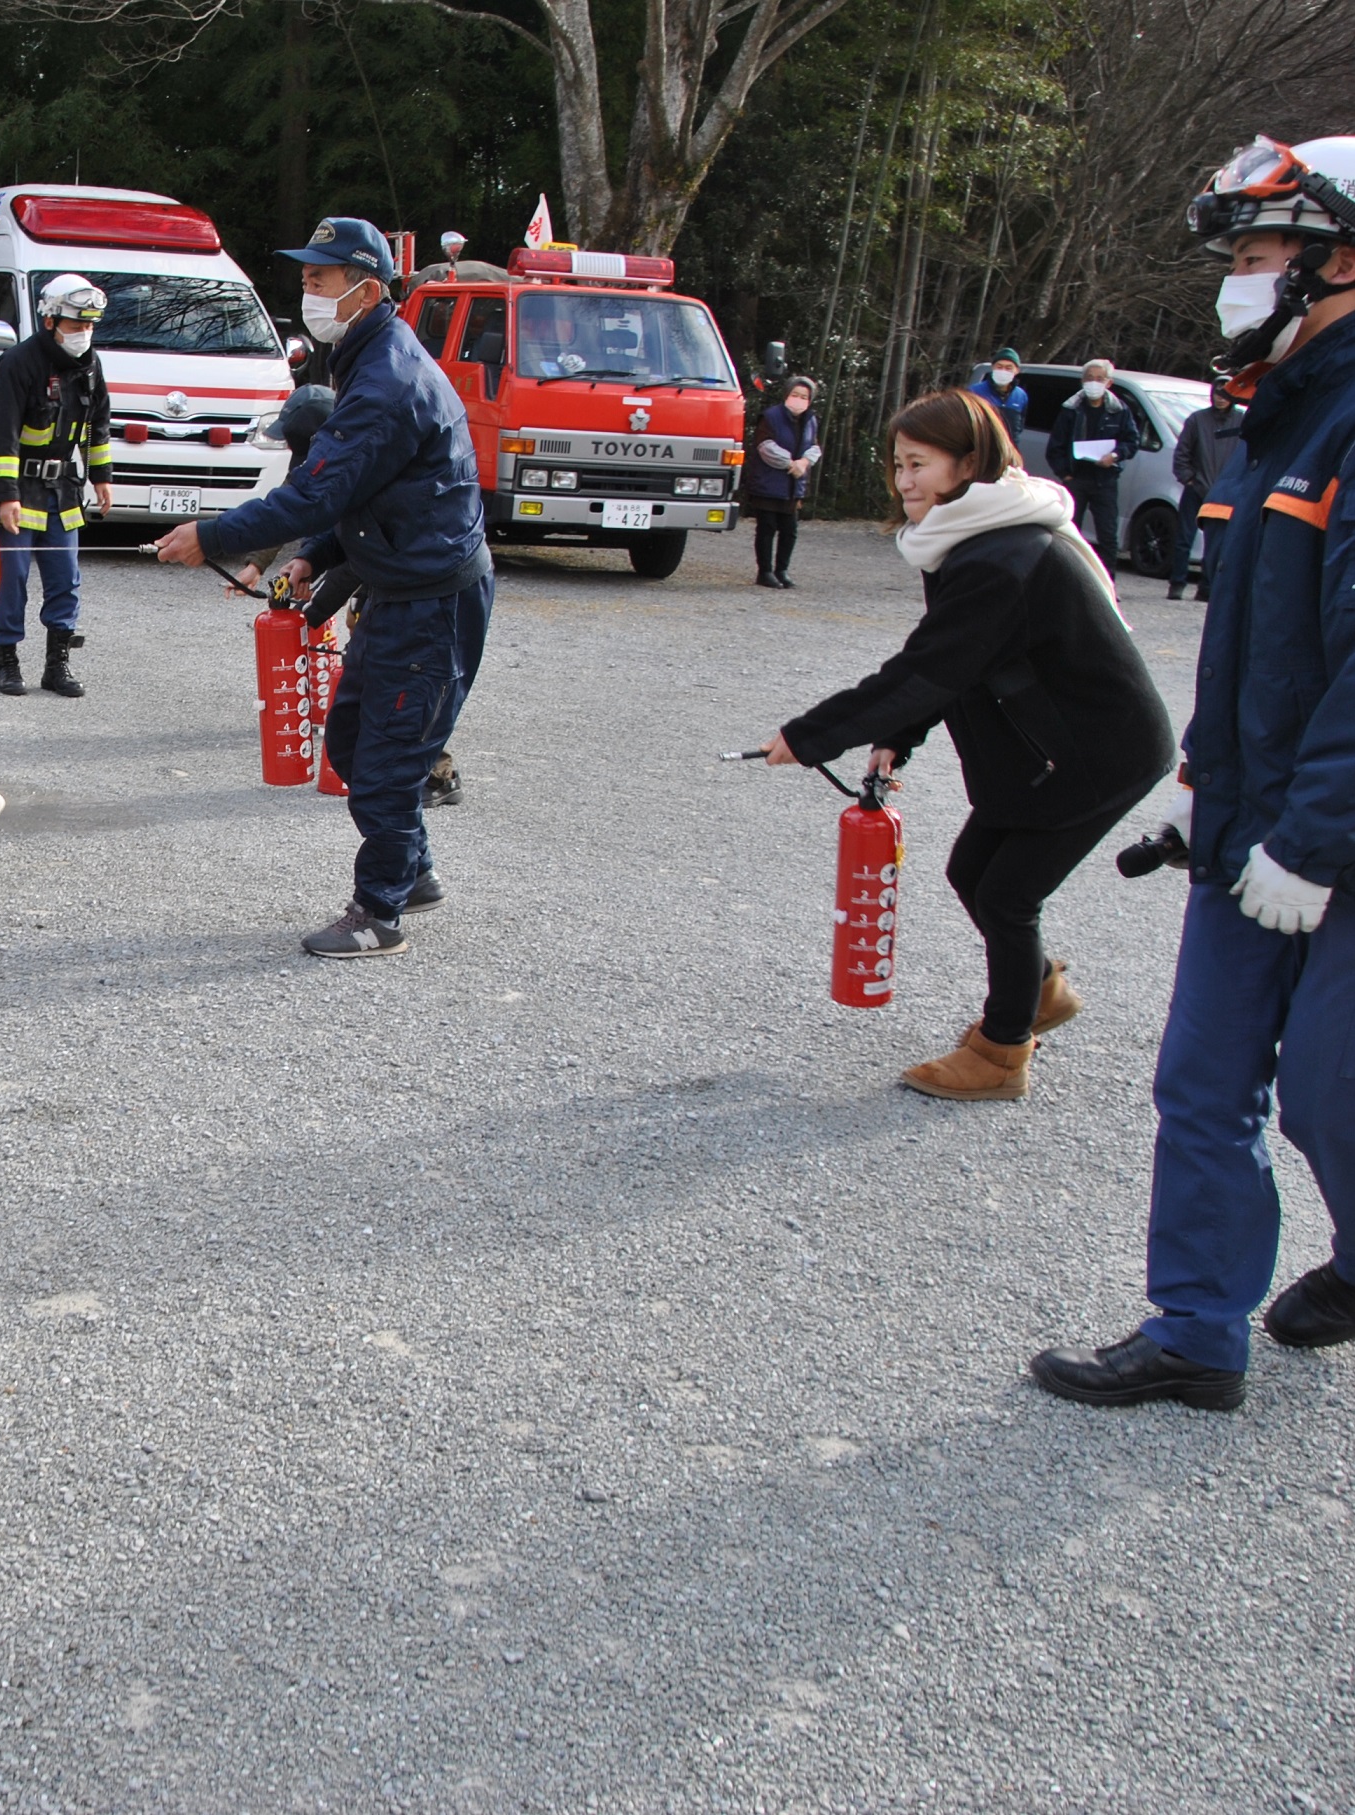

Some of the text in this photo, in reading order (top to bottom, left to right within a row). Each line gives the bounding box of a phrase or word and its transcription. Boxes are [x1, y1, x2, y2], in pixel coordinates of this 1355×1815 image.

[591, 441, 674, 459] TOYOTA
[160, 499, 197, 513] 61-58
[280, 658, 285, 667] 1
[281, 680, 287, 689] 2
[282, 702, 289, 711] 3
[283, 723, 290, 731] 4
[285, 744, 292, 753] 5
[863, 865, 869, 875] 1
[860, 890, 869, 899] 2
